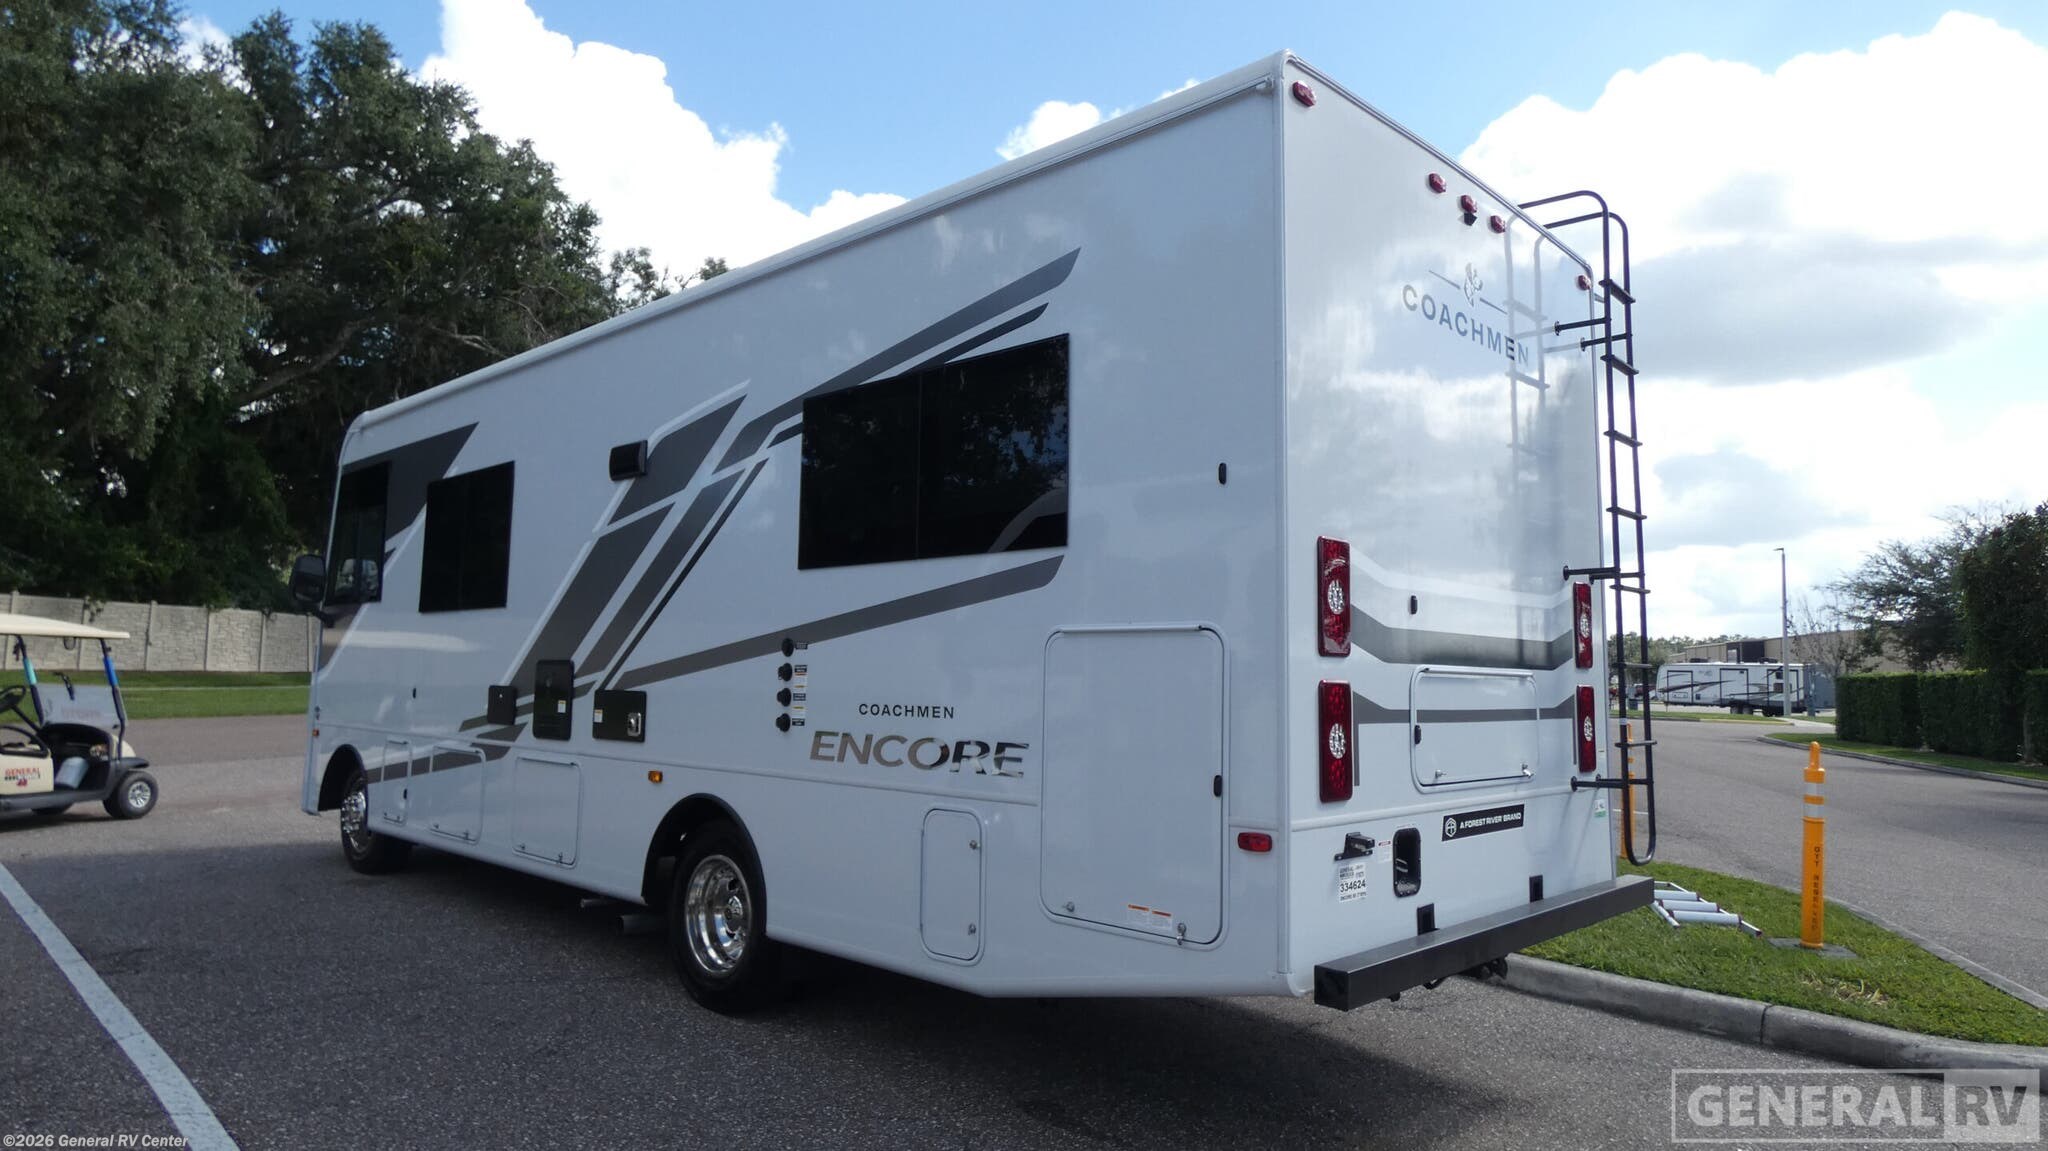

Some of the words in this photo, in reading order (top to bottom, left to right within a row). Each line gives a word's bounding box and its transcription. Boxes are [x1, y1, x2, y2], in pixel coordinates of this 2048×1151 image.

[1402, 284, 1529, 367] COACHMEN
[858, 703, 954, 719] COACHMEN
[809, 730, 1030, 778] ENCORE
[1465, 818, 1486, 829] FOREST
[1486, 815, 1502, 825] RIVER
[1503, 812, 1522, 822] BRAND
[1340, 880, 1366, 893] 334624
